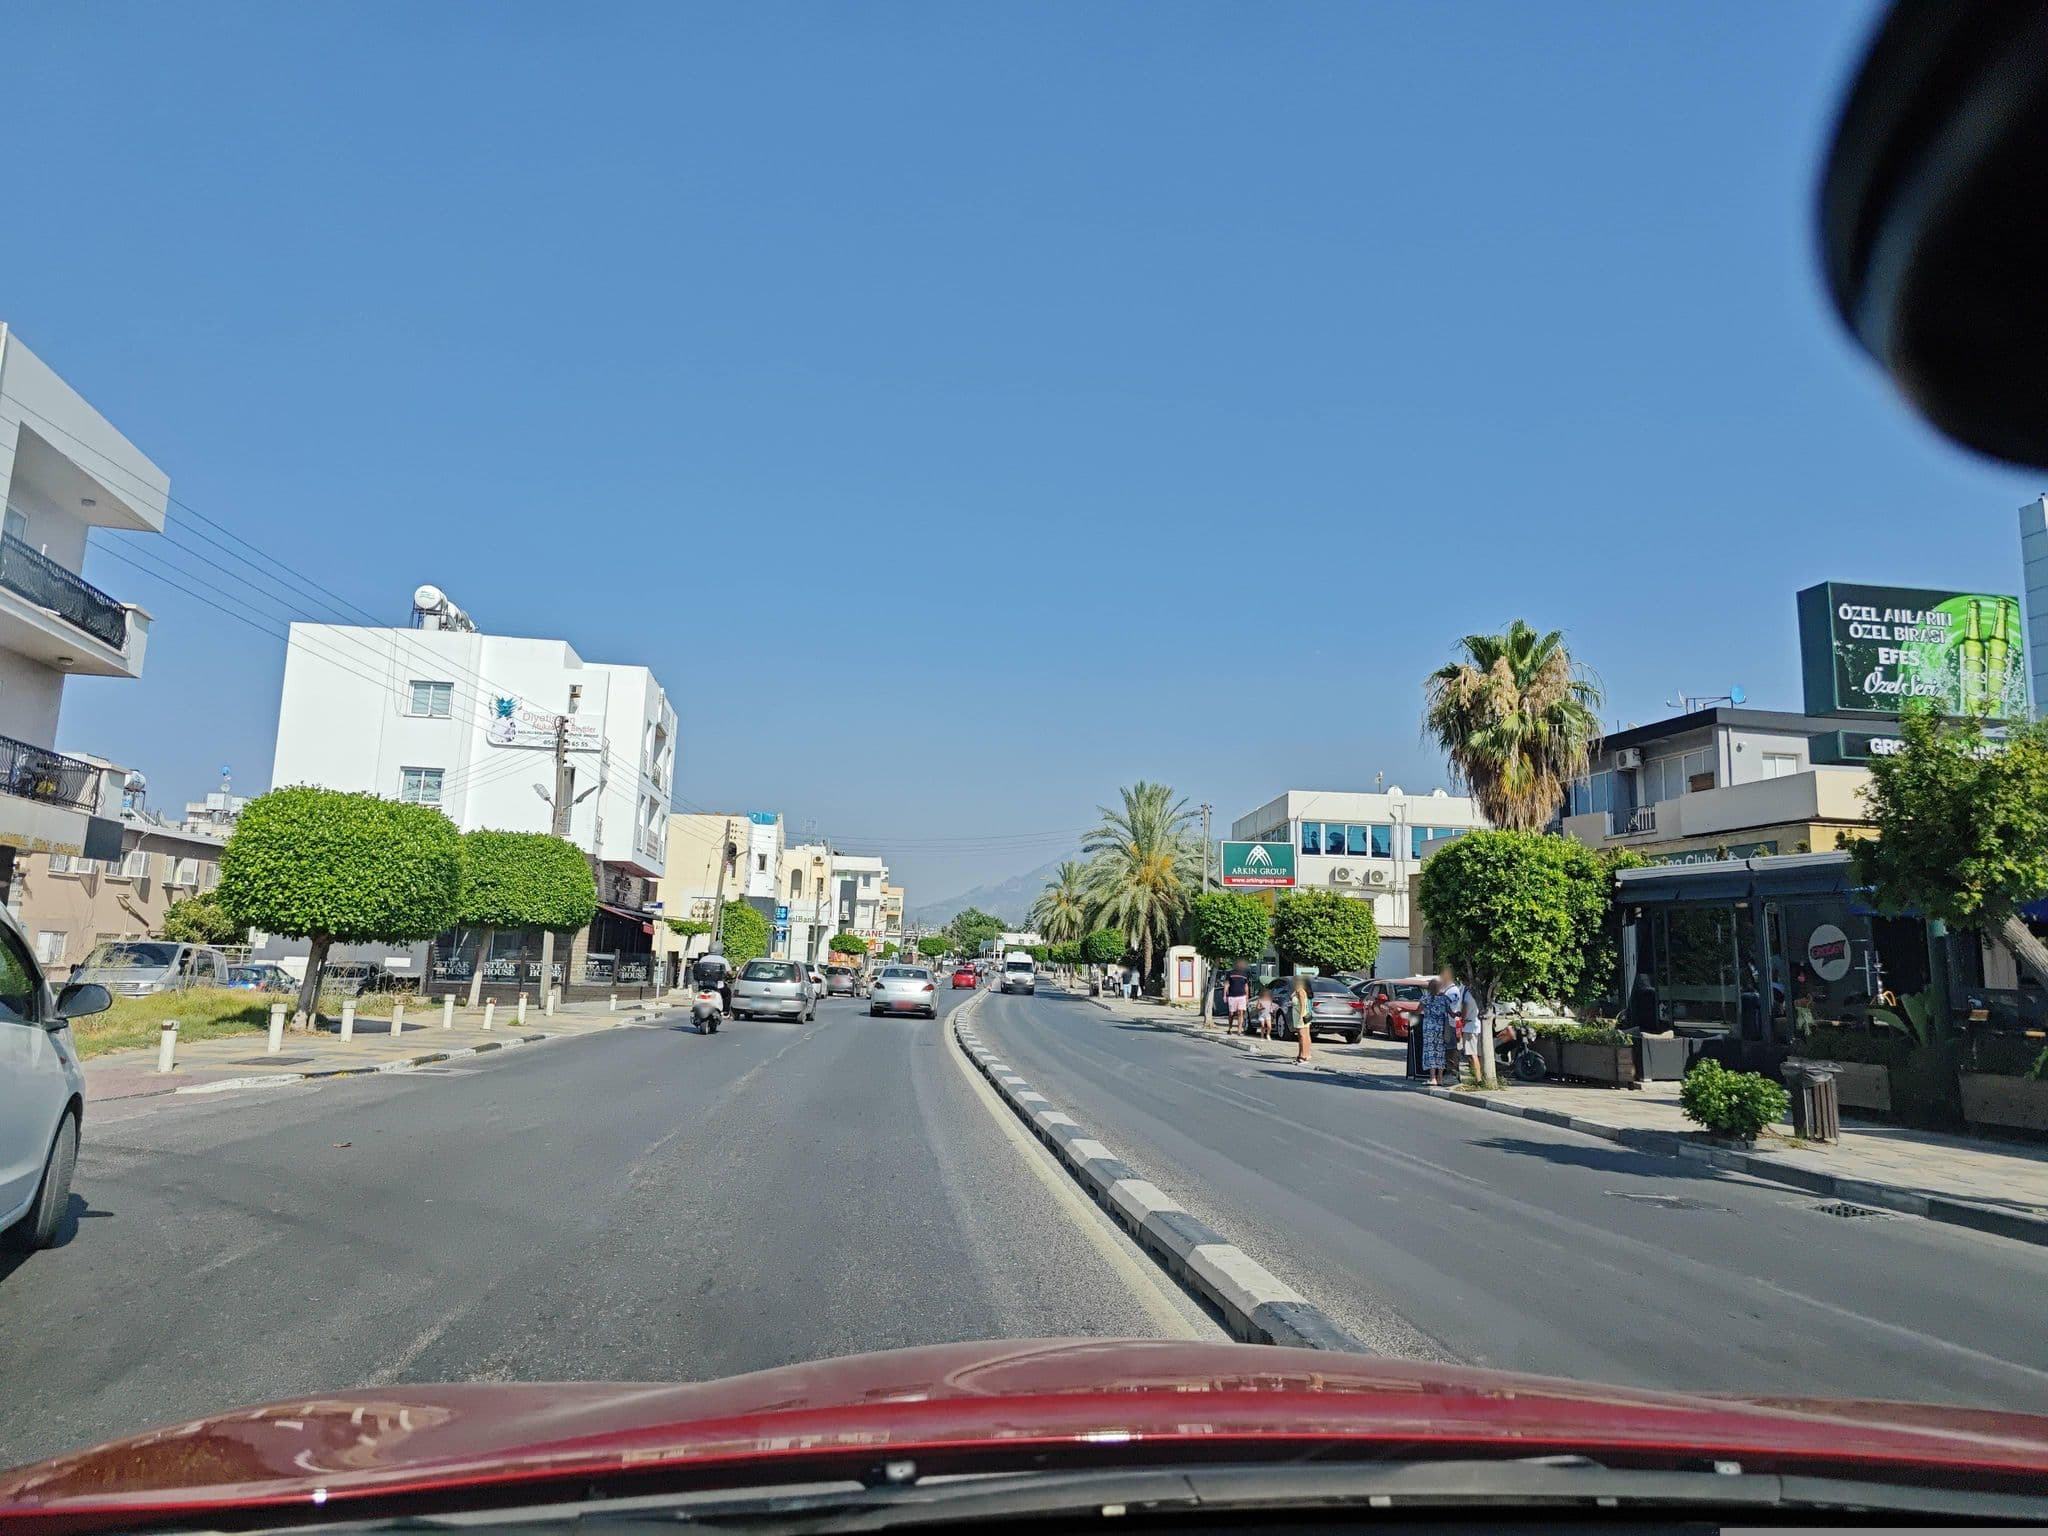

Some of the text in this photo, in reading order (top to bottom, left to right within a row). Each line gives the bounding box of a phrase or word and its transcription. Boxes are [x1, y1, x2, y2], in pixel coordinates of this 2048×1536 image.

[1839, 603, 1953, 627] ÖZEL ANLARIN
[1849, 622, 1892, 641] ÖZEL
[1878, 647, 1921, 666] EFES
[1864, 667, 1939, 697] Özel Seri
[1232, 867, 1287, 876] ARKIN GROUP
[847, 929, 883, 938] ECZANE
[434, 960, 470, 968] STEAK
[483, 961, 516, 969] STEAK
[529, 963, 561, 971] STAK
[483, 968, 516, 976] HOUSE
